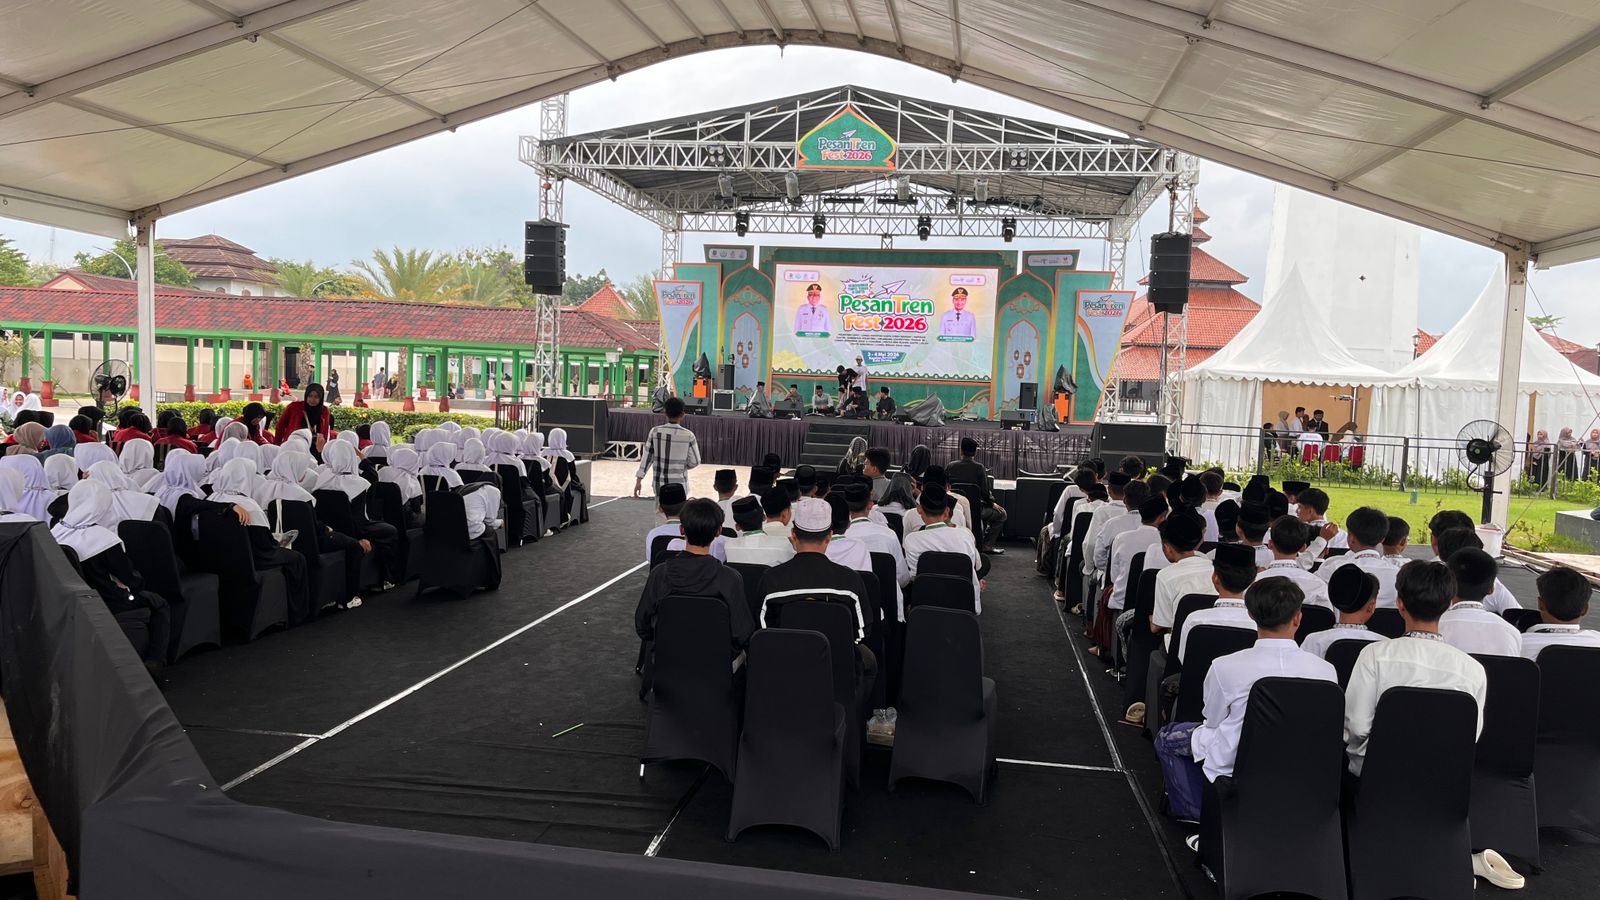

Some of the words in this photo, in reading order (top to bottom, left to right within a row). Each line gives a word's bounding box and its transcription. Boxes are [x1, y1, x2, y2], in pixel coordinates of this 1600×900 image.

[818, 137, 876, 150] PesanTren
[822, 150, 845, 160] Fest
[846, 151, 872, 160] 2026
[840, 295, 934, 314] PesanTren
[844, 315, 881, 330] Fest
[883, 317, 927, 331] 2026
